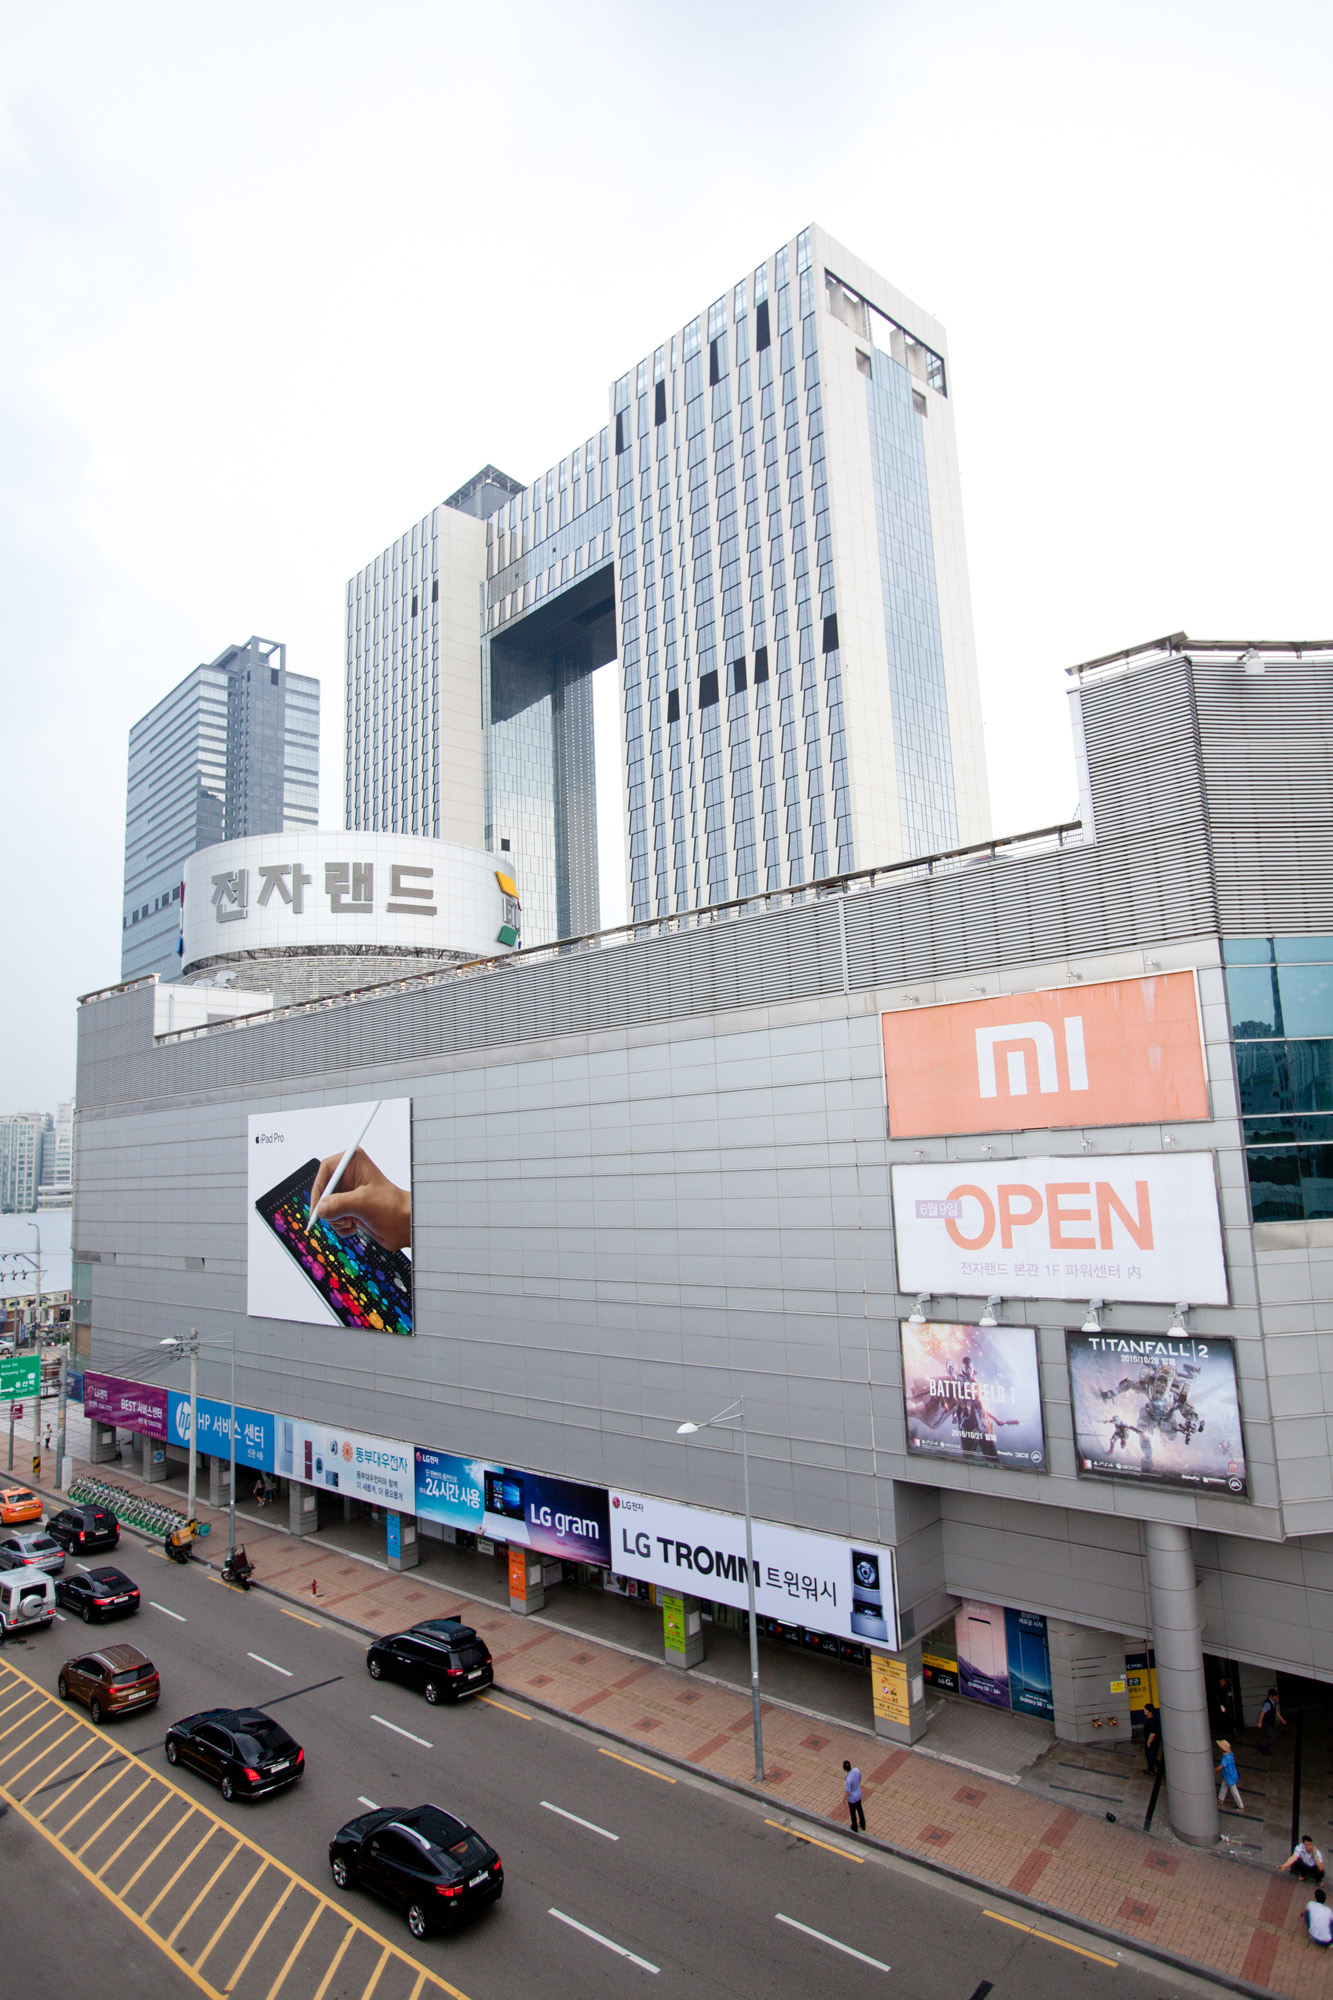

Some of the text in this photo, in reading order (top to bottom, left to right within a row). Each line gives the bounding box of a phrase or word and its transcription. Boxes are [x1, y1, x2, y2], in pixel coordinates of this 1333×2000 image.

[211, 862, 438, 923] 전자랜드
[260, 1133, 284, 1144] iPad Pro
[920, 1202, 958, 1217] 6월 9일
[944, 1180, 1154, 1250] OPEN
[960, 1261, 1009, 1276] 전자랜드
[1014, 1262, 1039, 1277] 본관
[1045, 1264, 1060, 1276] 1F
[1066, 1263, 1121, 1279] 파워센터
[1088, 1338, 1208, 1358] TITANFALL 2
[1120, 1355, 1159, 1365] 2016/10/28
[16, 1380, 34, 1388] 용산역
[929, 1379, 1016, 1404] BATTLEFIELD 1
[94, 1388, 108, 1400] LG전자
[120, 1398, 136, 1412] BEST
[138, 1402, 162, 1420] 서비스센터
[198, 1412, 264, 1448] HP 서비스 센터
[952, 1430, 982, 1440] 2016/10/21
[356, 1446, 408, 1474] 동부대우전자
[422, 1454, 439, 1465] LG전자
[356, 1470, 398, 1488] 동부대우전자와 함께
[356, 1482, 362, 1490] 더
[378, 1487, 384, 1496] 더
[385, 1488, 403, 1501] 풍요롭게
[425, 1478, 459, 1503] 24시간
[460, 1487, 480, 1508] 사용
[621, 1500, 644, 1514] LG전자
[530, 1503, 599, 1540] LG gram
[622, 1528, 838, 1607] LG TROMM 트윈워시
[968, 1681, 983, 1690] Galaxy
[1019, 1696, 1036, 1706] Galaxy
